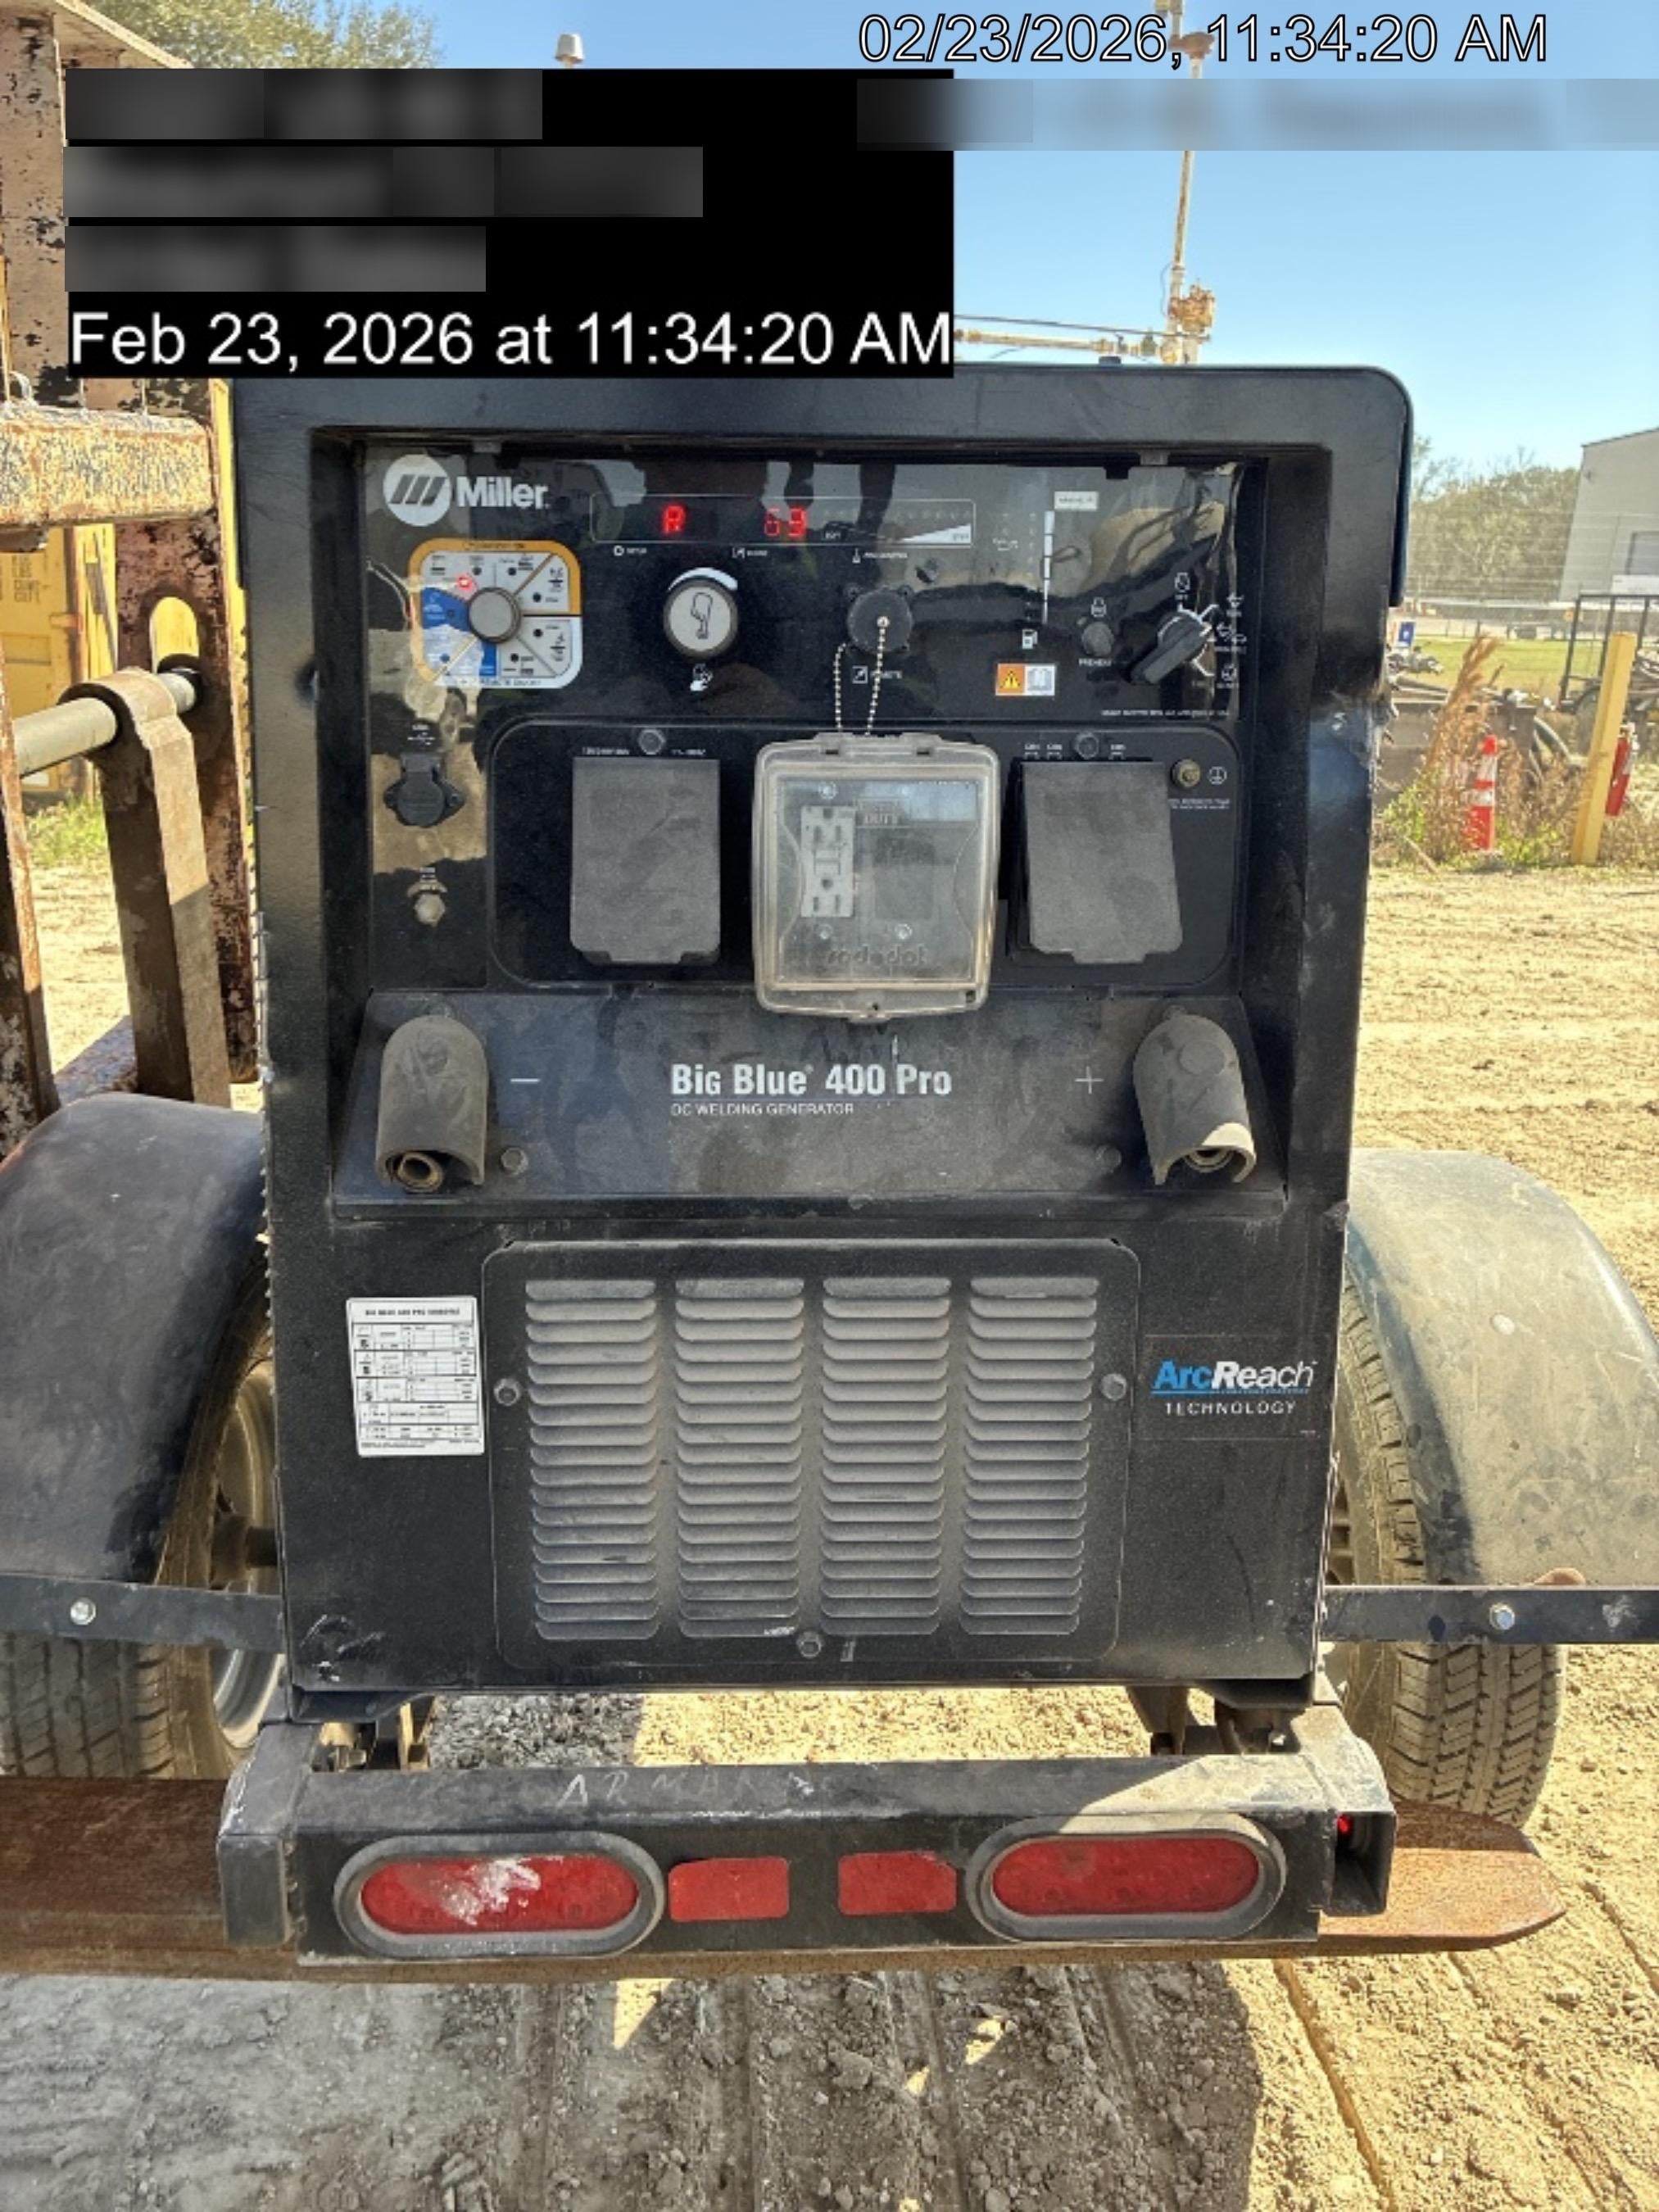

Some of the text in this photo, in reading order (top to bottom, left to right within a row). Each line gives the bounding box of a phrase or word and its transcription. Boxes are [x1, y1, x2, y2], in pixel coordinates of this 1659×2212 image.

[456, 476, 549, 509] Miller
[671, 1063, 721, 1096] Big
[824, 1063, 886, 1096] 400
[895, 1063, 953, 1096] Pro
[696, 1104, 763, 1117] WELDING
[765, 1103, 854, 1116] GENERATOR
[1153, 1360, 1315, 1390] ArcReach
[1165, 1400, 1297, 1416] TECHNOLOGY
